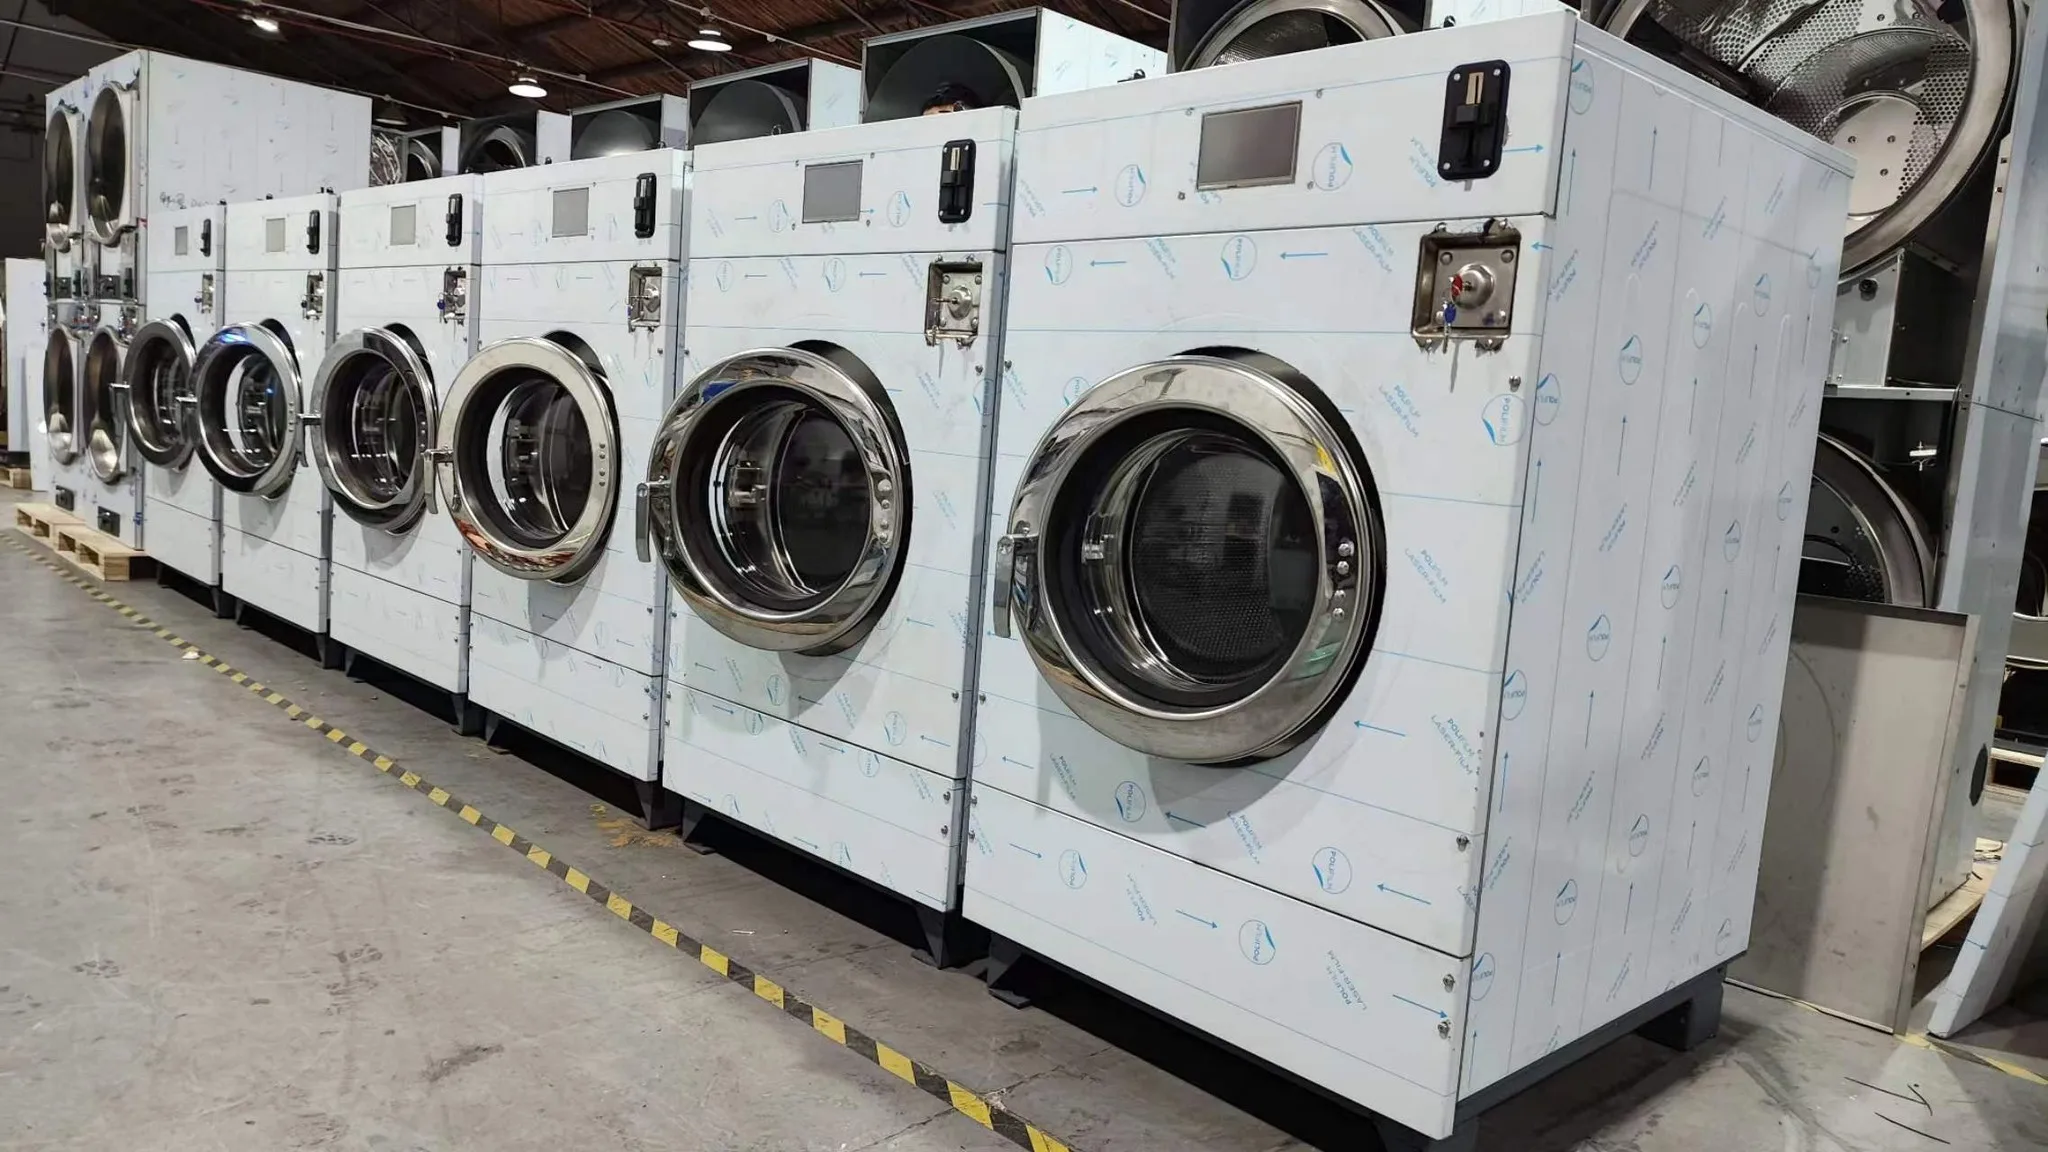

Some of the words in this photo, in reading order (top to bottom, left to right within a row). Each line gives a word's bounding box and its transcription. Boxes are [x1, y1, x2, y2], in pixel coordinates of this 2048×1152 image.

[1501, 397, 1511, 444] POLIFILM
[1447, 717, 1476, 757] POLIFILM
[1327, 850, 1337, 890] POLIFILM
[1325, 964, 1353, 1006] POLIFILM
[1326, 949, 1369, 1012] LASER-FILM
